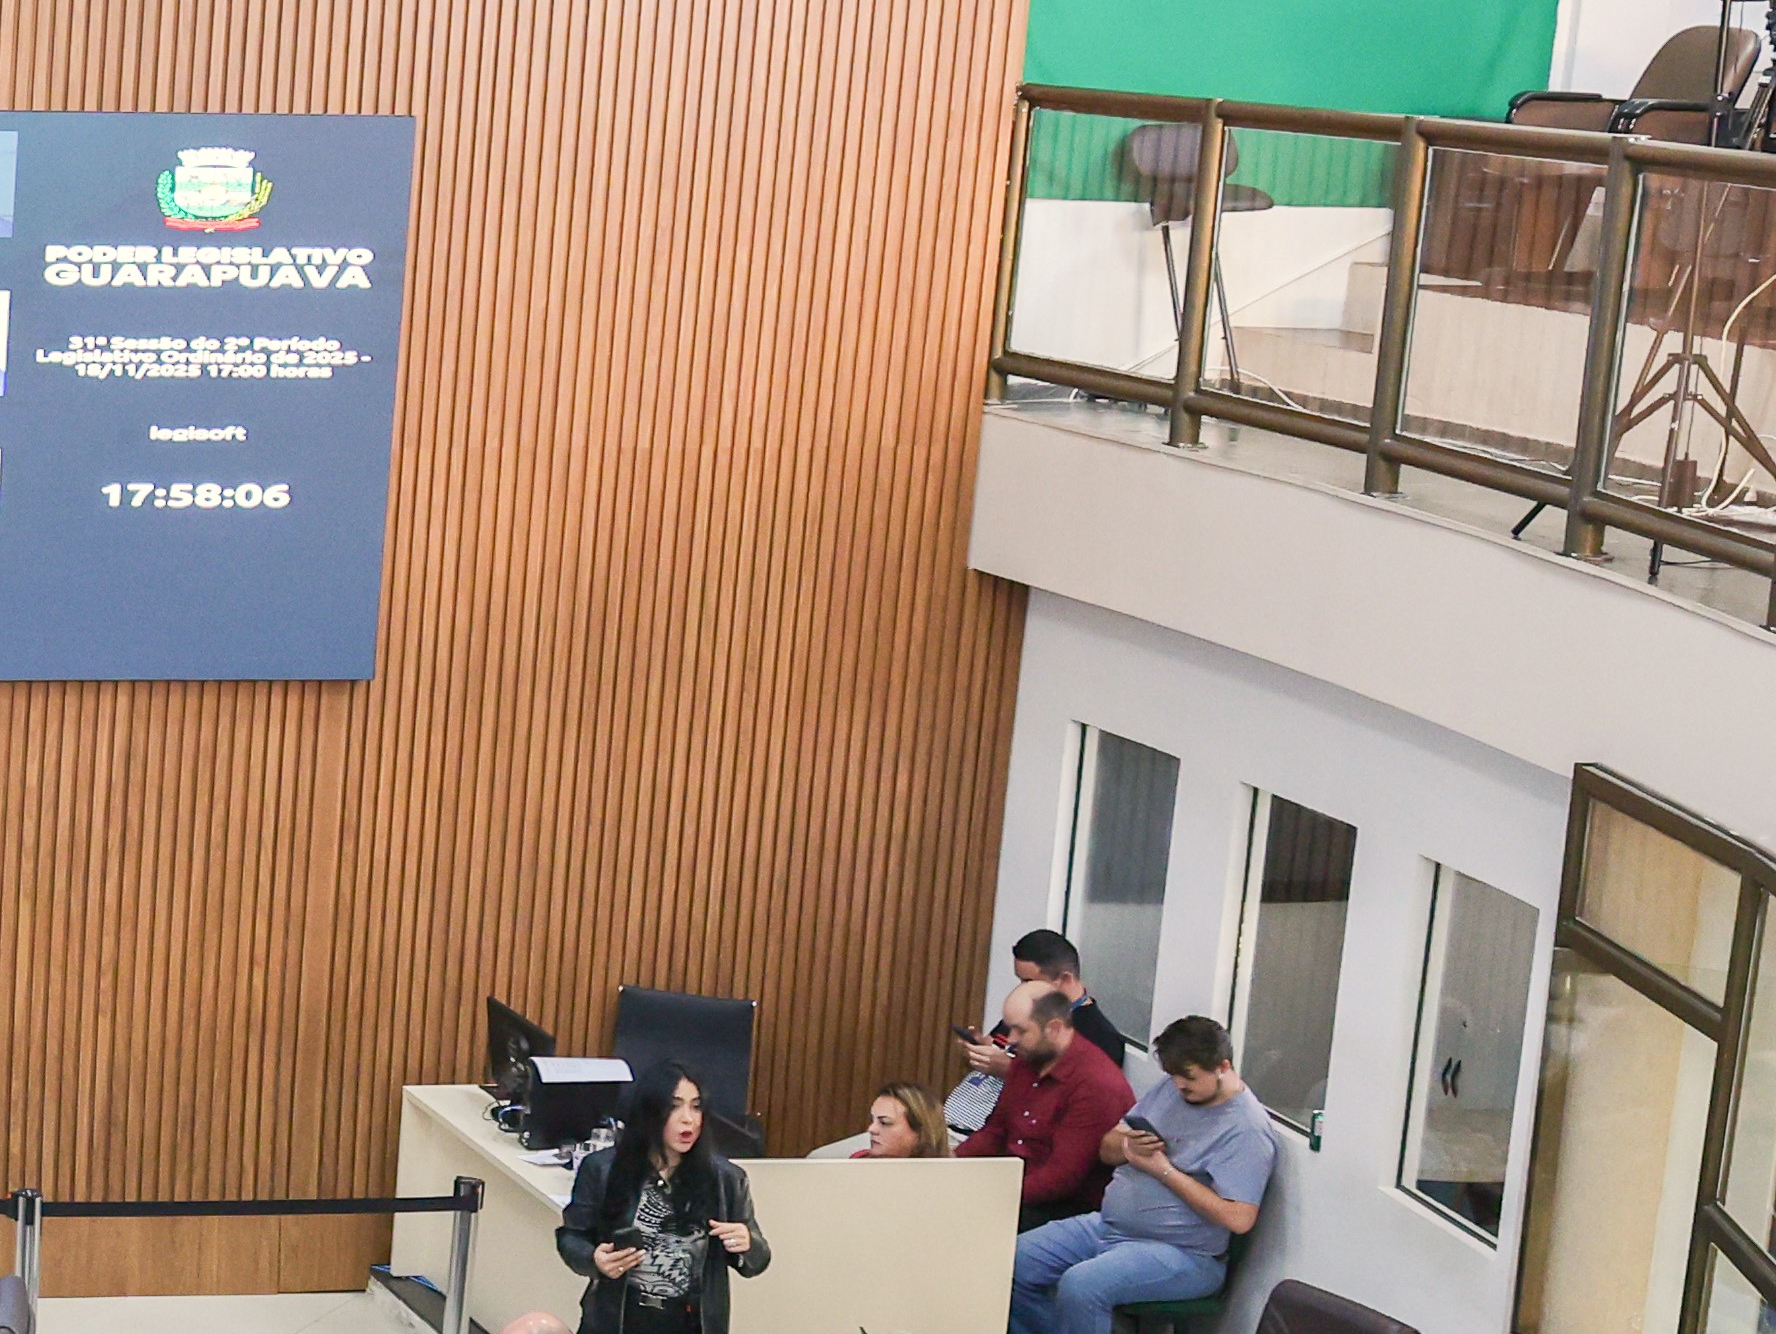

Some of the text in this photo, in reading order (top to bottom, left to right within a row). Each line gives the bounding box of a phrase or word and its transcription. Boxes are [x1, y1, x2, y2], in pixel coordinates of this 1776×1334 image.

[45, 244, 374, 265] PODER LEGISLATIVO
[44, 262, 372, 289] GUARAPUAVA
[110, 336, 187, 350] Sessão
[189, 336, 221, 351] do
[253, 336, 342, 351] Período
[36, 349, 157, 366] Legislativo
[160, 349, 267, 364] Ordinário
[270, 350, 300, 365] de
[303, 351, 358, 365] 2025
[207, 364, 267, 378] 17:00
[270, 364, 334, 378] horas
[149, 426, 247, 442] legisoft
[101, 483, 291, 508] 17:58:06
